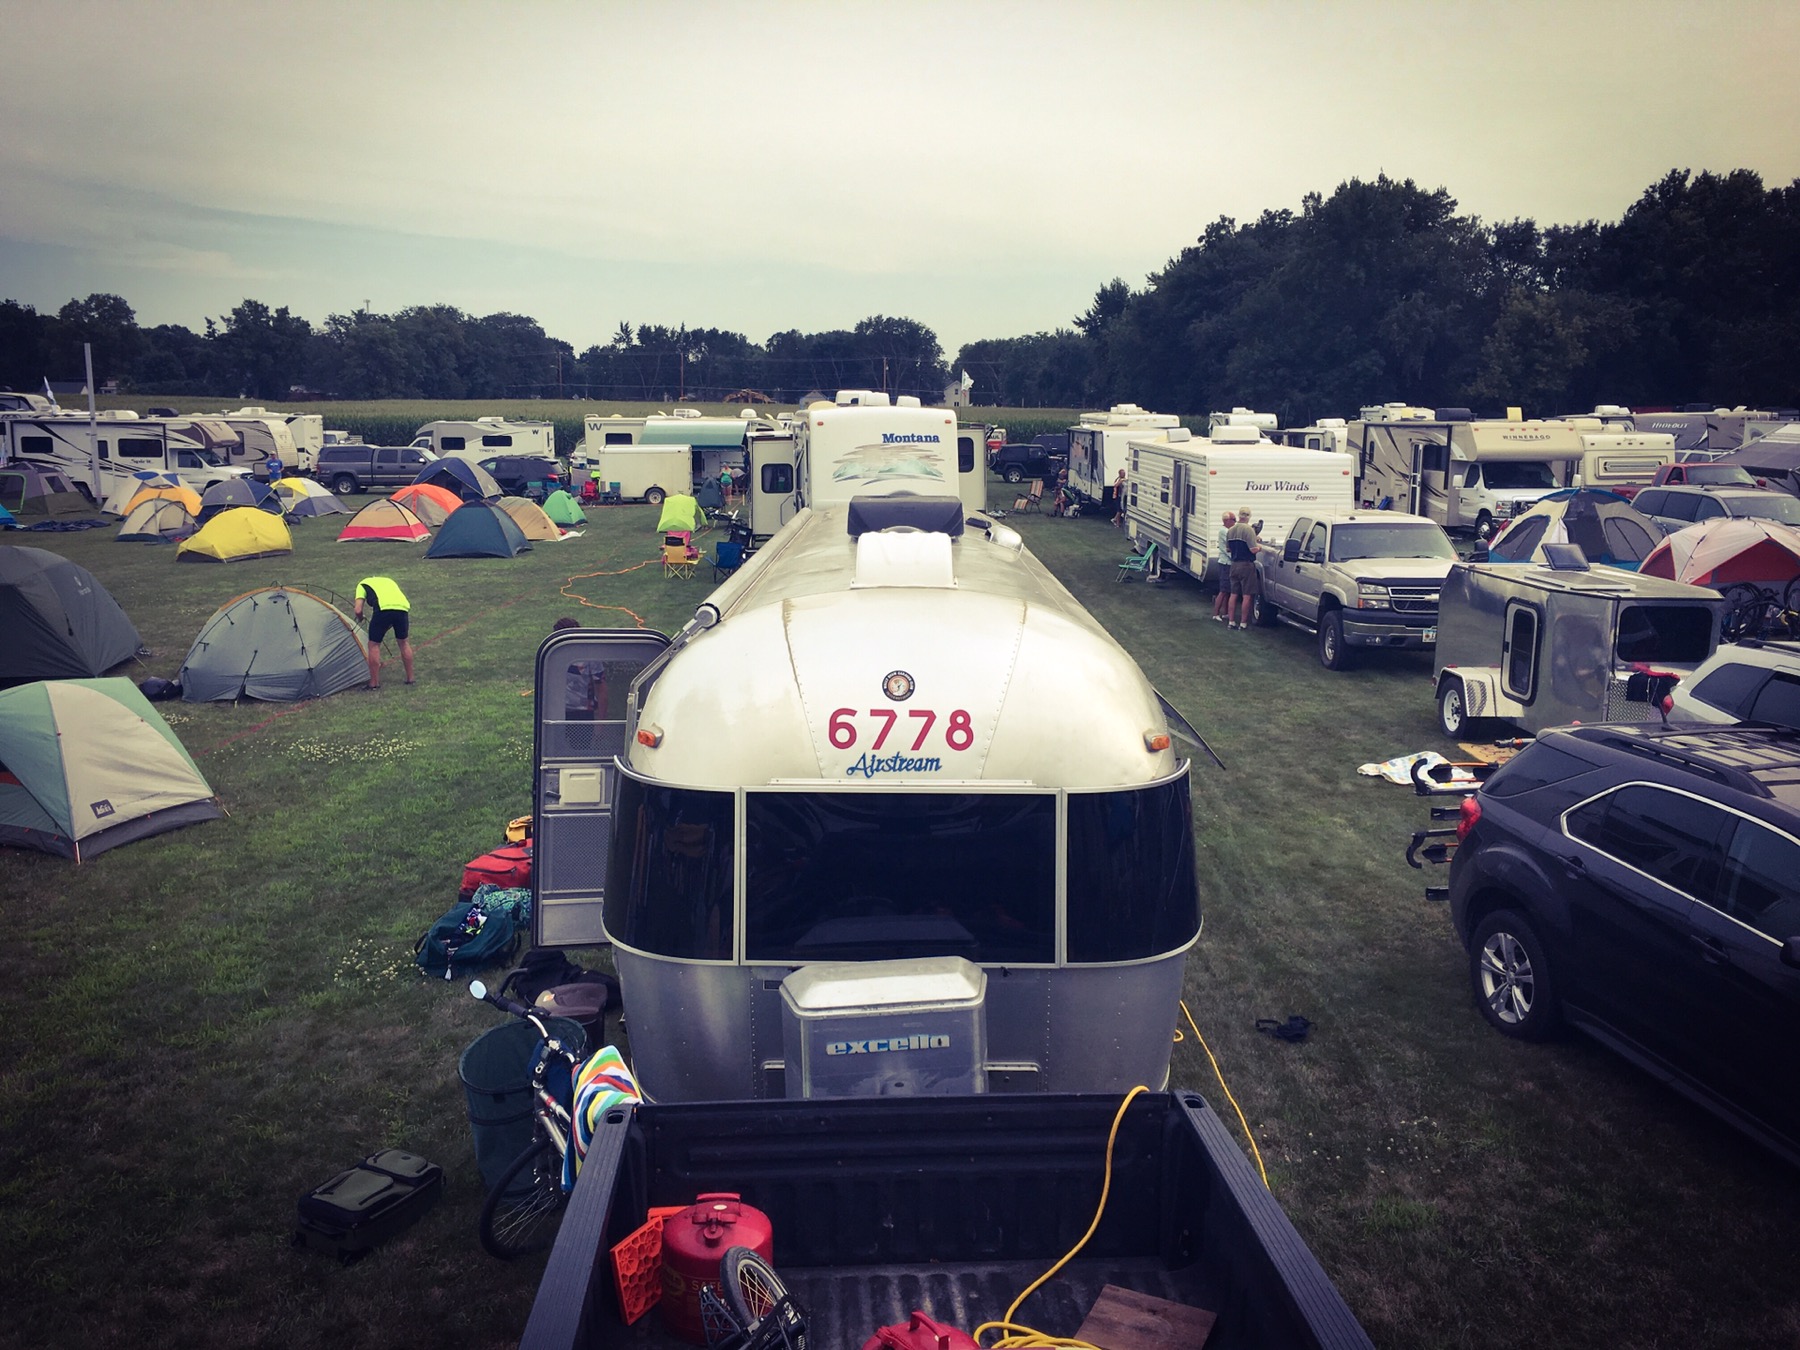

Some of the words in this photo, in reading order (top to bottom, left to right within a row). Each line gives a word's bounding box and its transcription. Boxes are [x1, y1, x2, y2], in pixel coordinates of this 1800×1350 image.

[882, 433, 940, 443] Montana
[1245, 480, 1272, 491] Four
[1275, 480, 1309, 491] Winds
[828, 708, 974, 751] 6778
[846, 751, 943, 779] Airstream
